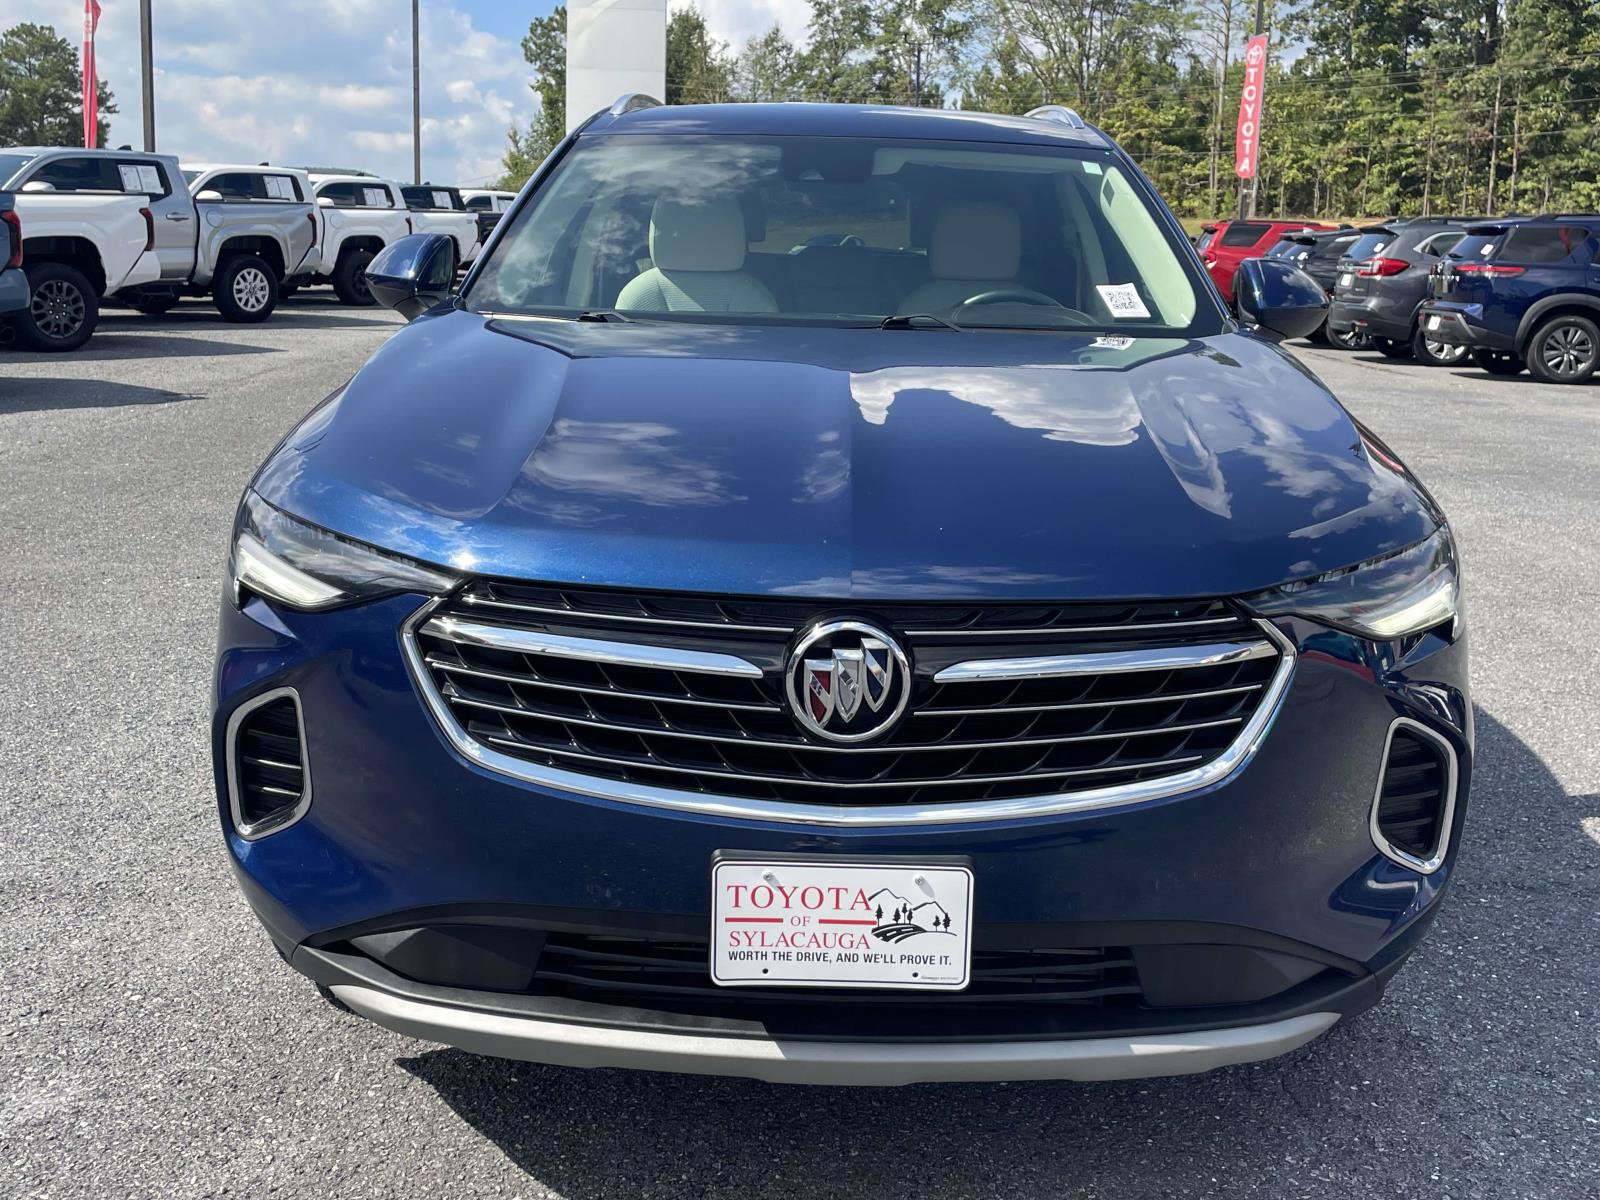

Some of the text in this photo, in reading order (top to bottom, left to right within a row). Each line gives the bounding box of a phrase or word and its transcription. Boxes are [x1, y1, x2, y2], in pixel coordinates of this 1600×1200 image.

[1239, 67, 1258, 173] TOYOTA
[726, 885, 872, 911] TOYOTA
[790, 915, 811, 927] OF
[729, 930, 871, 950] SYLACAUGA
[728, 950, 952, 966] WORTH THE DRIVE, AND WE'LL PROVE IT.
